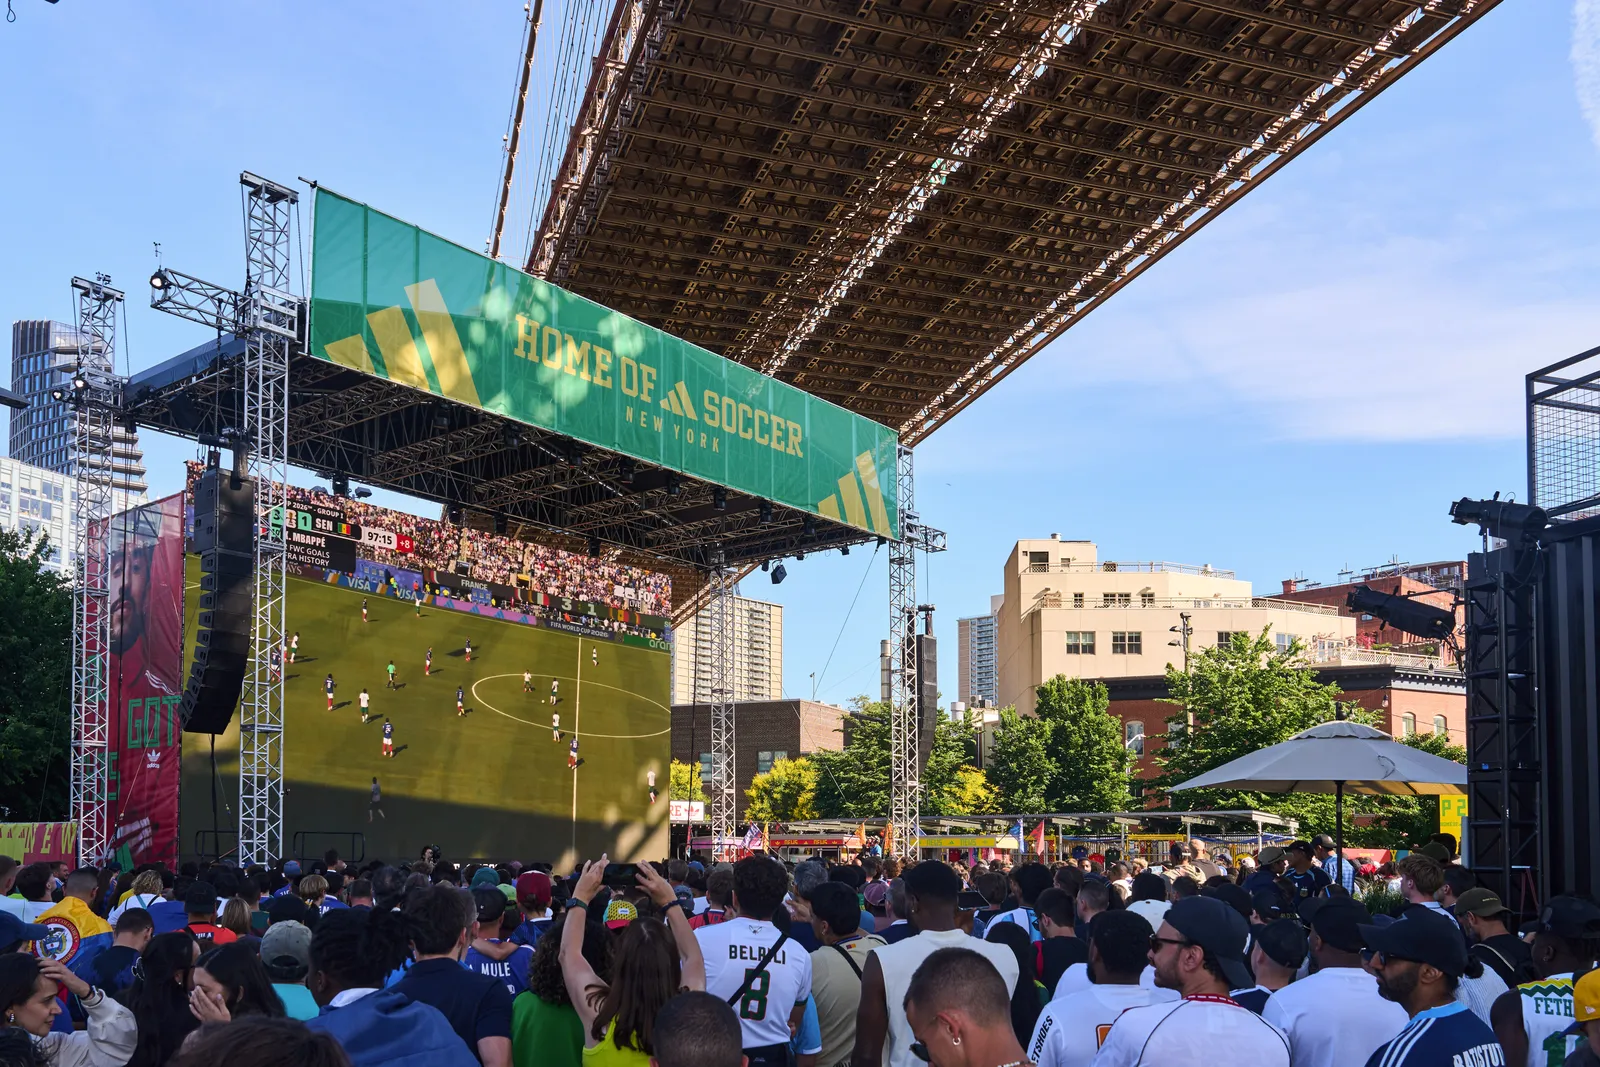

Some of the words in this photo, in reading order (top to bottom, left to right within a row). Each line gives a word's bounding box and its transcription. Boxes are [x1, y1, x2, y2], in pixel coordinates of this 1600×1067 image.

[514, 313, 612, 389] HOME
[621, 356, 657, 404] OF
[704, 389, 803, 458] SOCCER
[626, 405, 663, 433] NEW
[674, 424, 719, 453] YORK
[317, 508, 340, 518] GROUP
[293, 532, 326, 548] MBAPPÉ
[301, 515, 308, 527] 1
[315, 518, 333, 531] SEN
[367, 532, 392, 545] 97:15
[400, 539, 410, 549] +8
[290, 544, 305, 554] FWC
[306, 548, 330, 559] GOALS
[299, 554, 330, 567] HISTORY
[346, 577, 371, 592] VISA
[461, 579, 488, 591] FRANCE
[638, 589, 656, 603] FOX
[561, 598, 572, 611] 3
[587, 603, 597, 616] 1
[550, 621, 561, 629] FIFA
[561, 623, 580, 633] WORLD
[128, 695, 181, 748] GOT
[729, 944, 786, 965] BELALI
[481, 961, 511, 977] MULE
[740, 968, 770, 1021] 8
